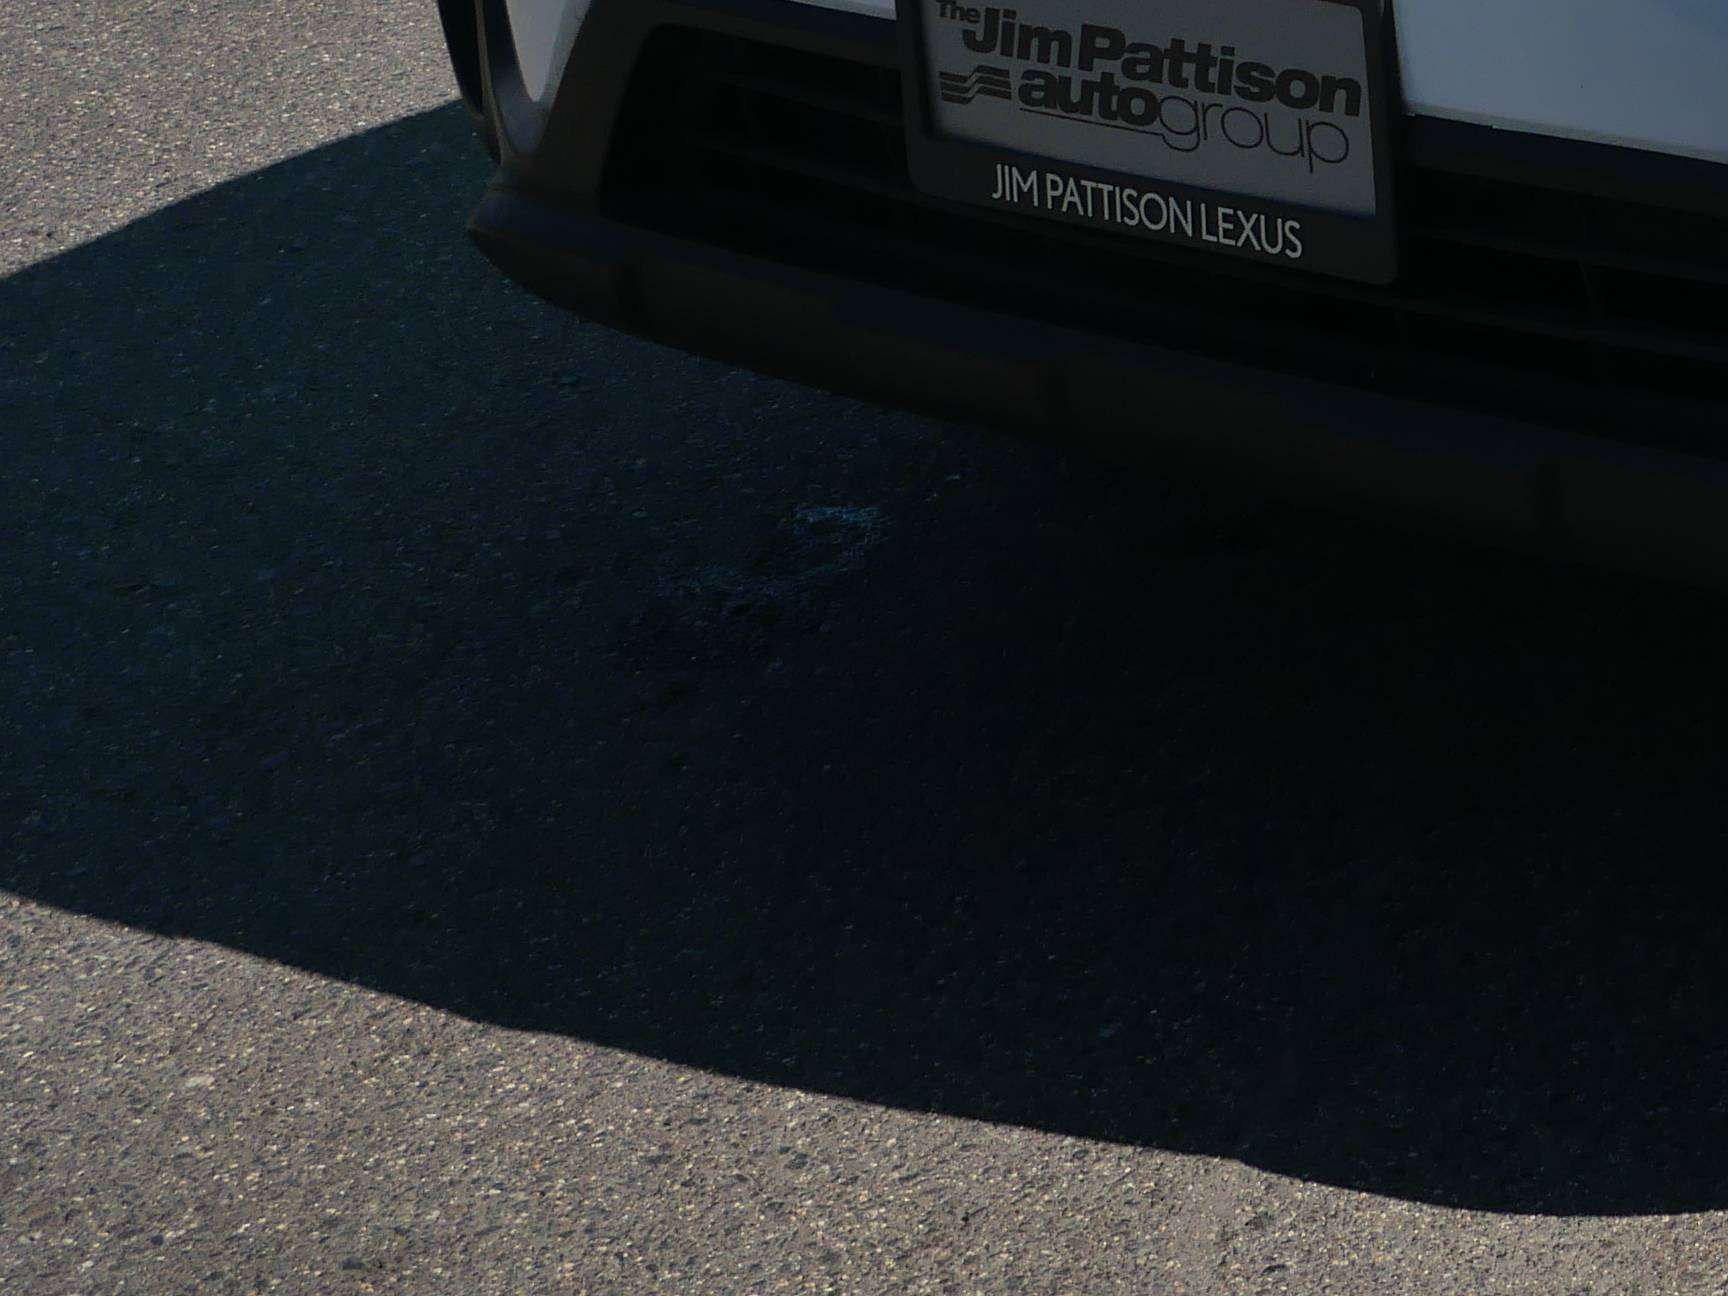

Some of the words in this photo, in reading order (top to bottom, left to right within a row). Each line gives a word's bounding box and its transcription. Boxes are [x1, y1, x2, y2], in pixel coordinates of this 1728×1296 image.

[991, 162, 1038, 208] JIM
[1046, 172, 1193, 237] PATTISON
[1200, 205, 1302, 259] LEXUS
